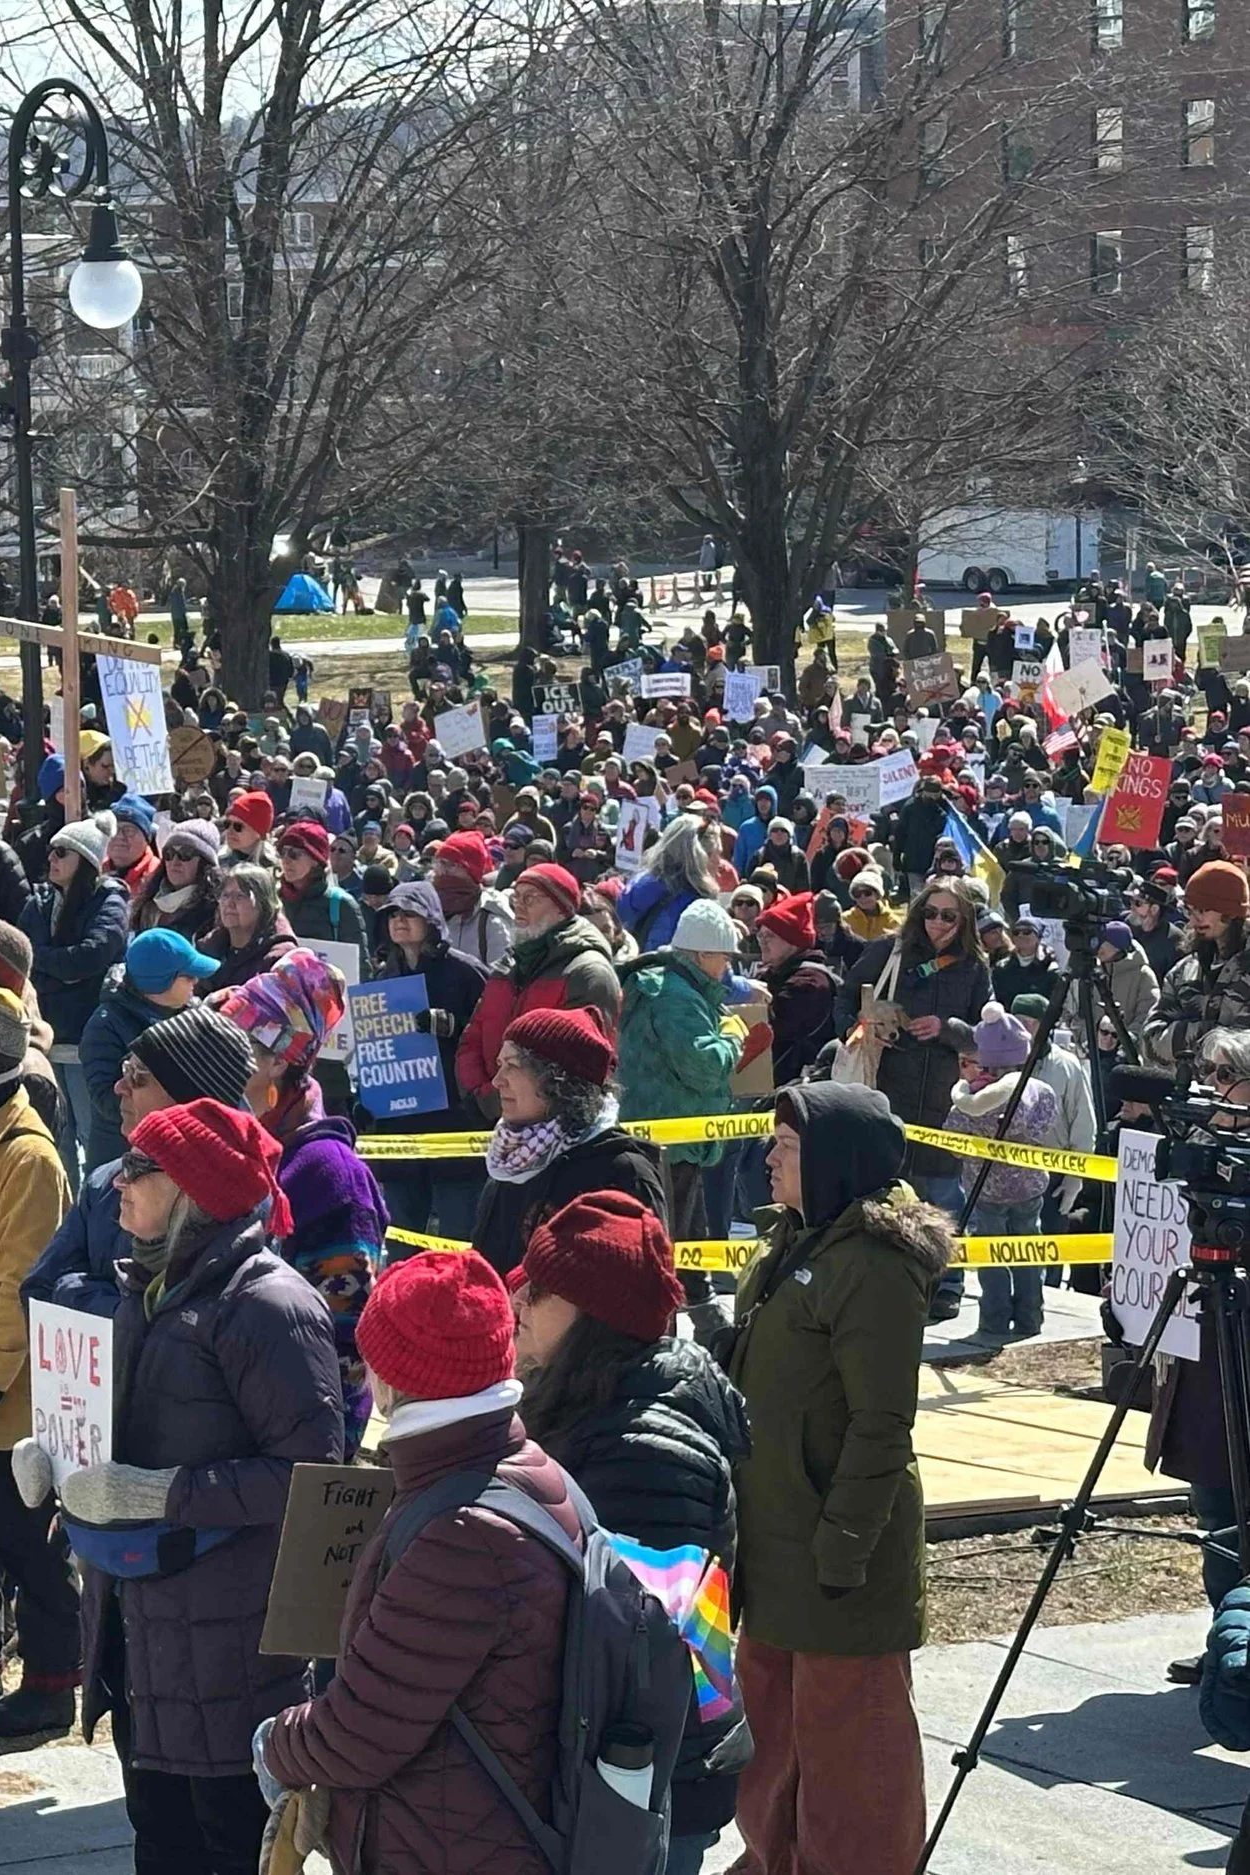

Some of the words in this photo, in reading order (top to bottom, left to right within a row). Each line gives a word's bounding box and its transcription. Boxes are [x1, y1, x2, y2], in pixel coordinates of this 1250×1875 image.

[1020, 663, 1041, 677] NO
[544, 686, 571, 699] ICE
[882, 764, 916, 784] SILENT
[1128, 757, 1153, 776] NO
[1115, 774, 1162, 799] KINGS
[352, 992, 387, 1017] FREE
[354, 1012, 416, 1041] SPEECH
[357, 1039, 396, 1065] FREE
[360, 1056, 438, 1088] COUNTRY
[390, 1097, 418, 1111] ACLU
[1122, 1180, 1186, 1225] NEEDS
[990, 1241, 1059, 1263] CAUTION
[1123, 1218, 1179, 1269] YOUR
[725, 1246, 754, 1268] NO
[1113, 1264, 1196, 1320] COUR
[38, 1322, 101, 1387] LOVE
[34, 1407, 102, 1467] POWER
[323, 1542, 362, 1567] NOT
